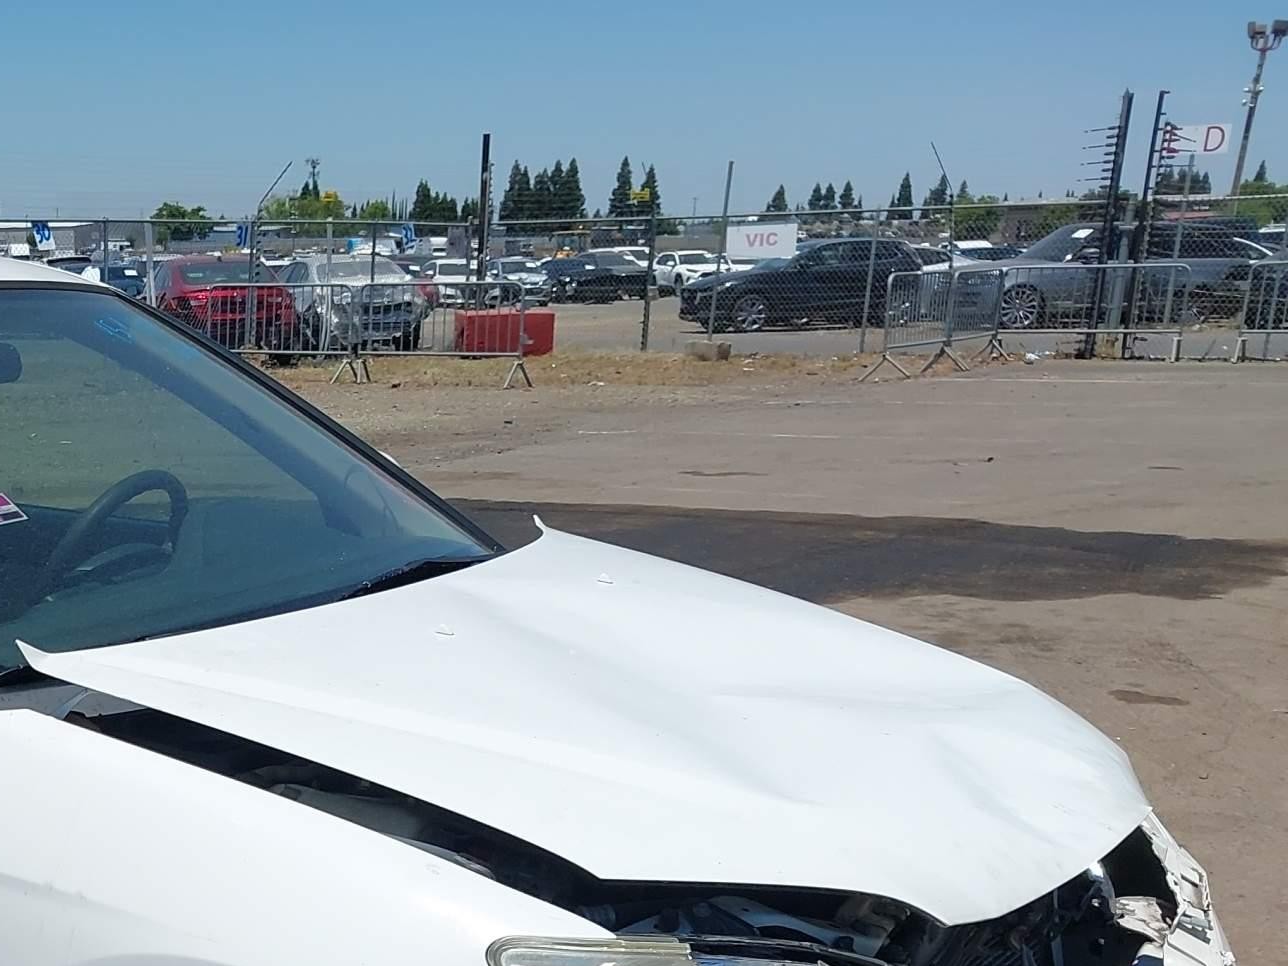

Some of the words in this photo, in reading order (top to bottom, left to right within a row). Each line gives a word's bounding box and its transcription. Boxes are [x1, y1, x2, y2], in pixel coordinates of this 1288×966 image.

[1203, 126, 1225, 152] D
[33, 223, 51, 244] 30
[236, 225, 249, 247] 31
[745, 232, 778, 248] VIC
